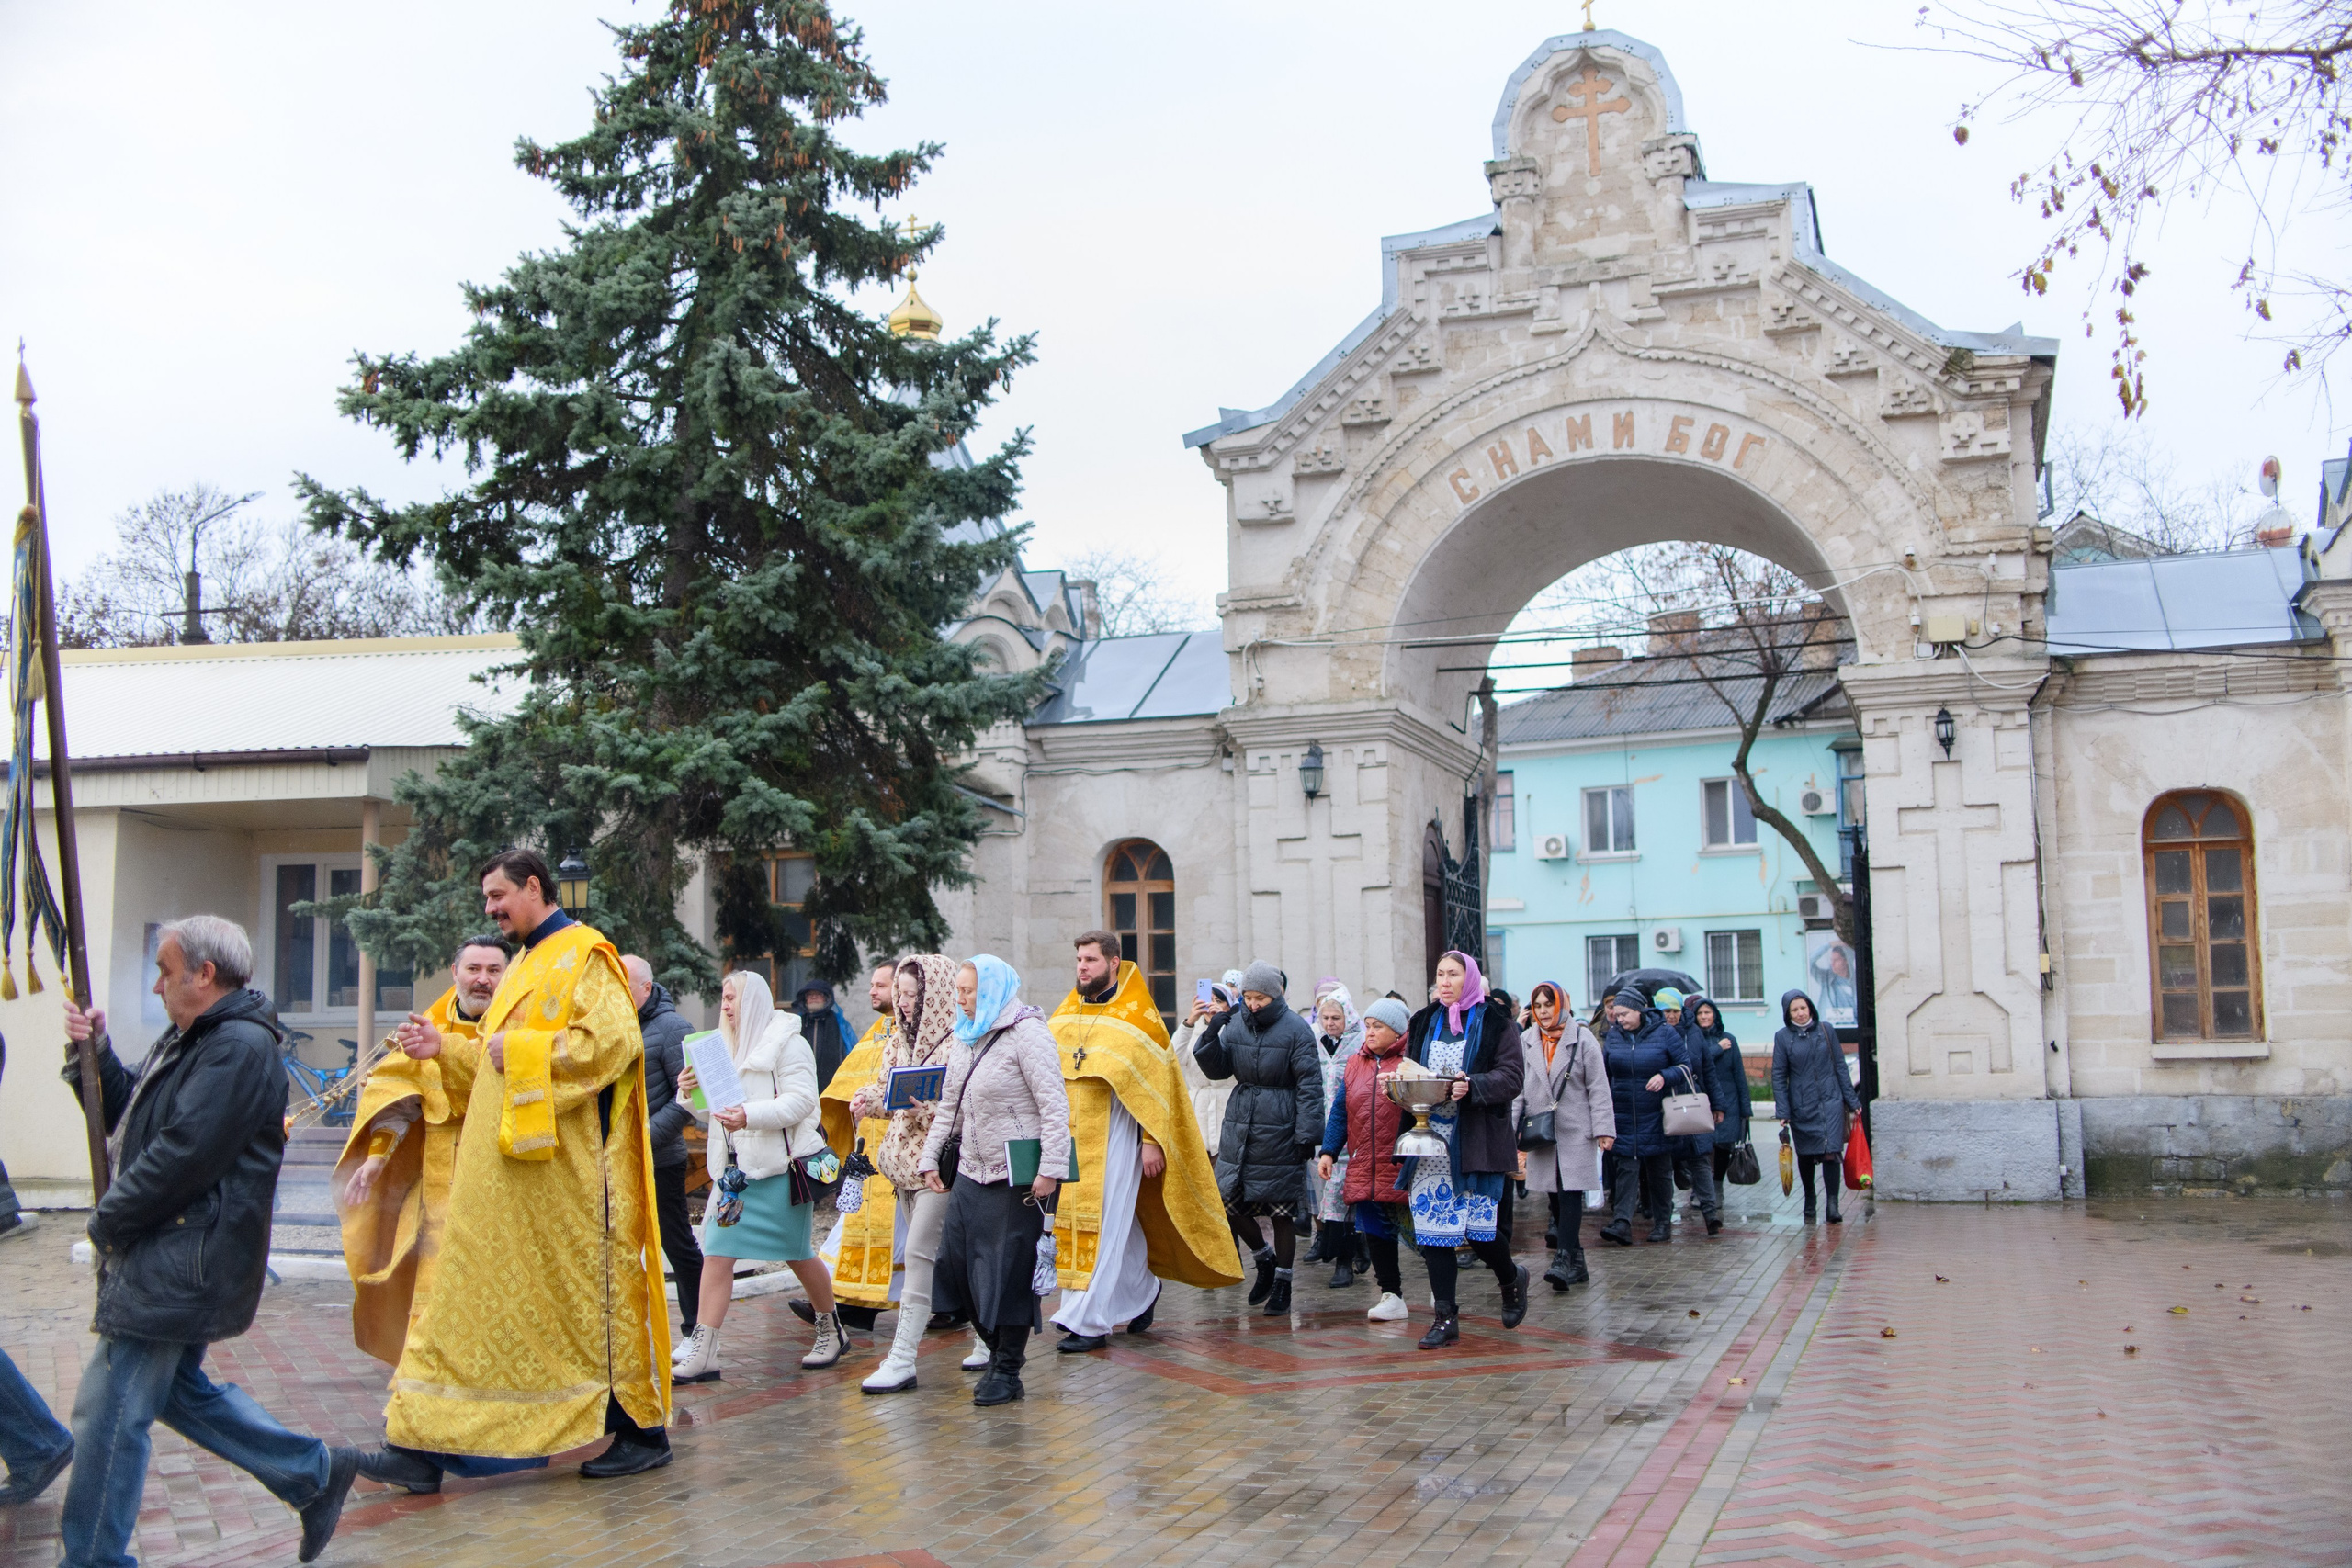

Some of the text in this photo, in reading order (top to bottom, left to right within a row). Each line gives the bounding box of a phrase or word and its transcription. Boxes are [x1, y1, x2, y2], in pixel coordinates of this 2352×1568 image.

[1448, 412, 1766, 505] С НАМИ БОГ
